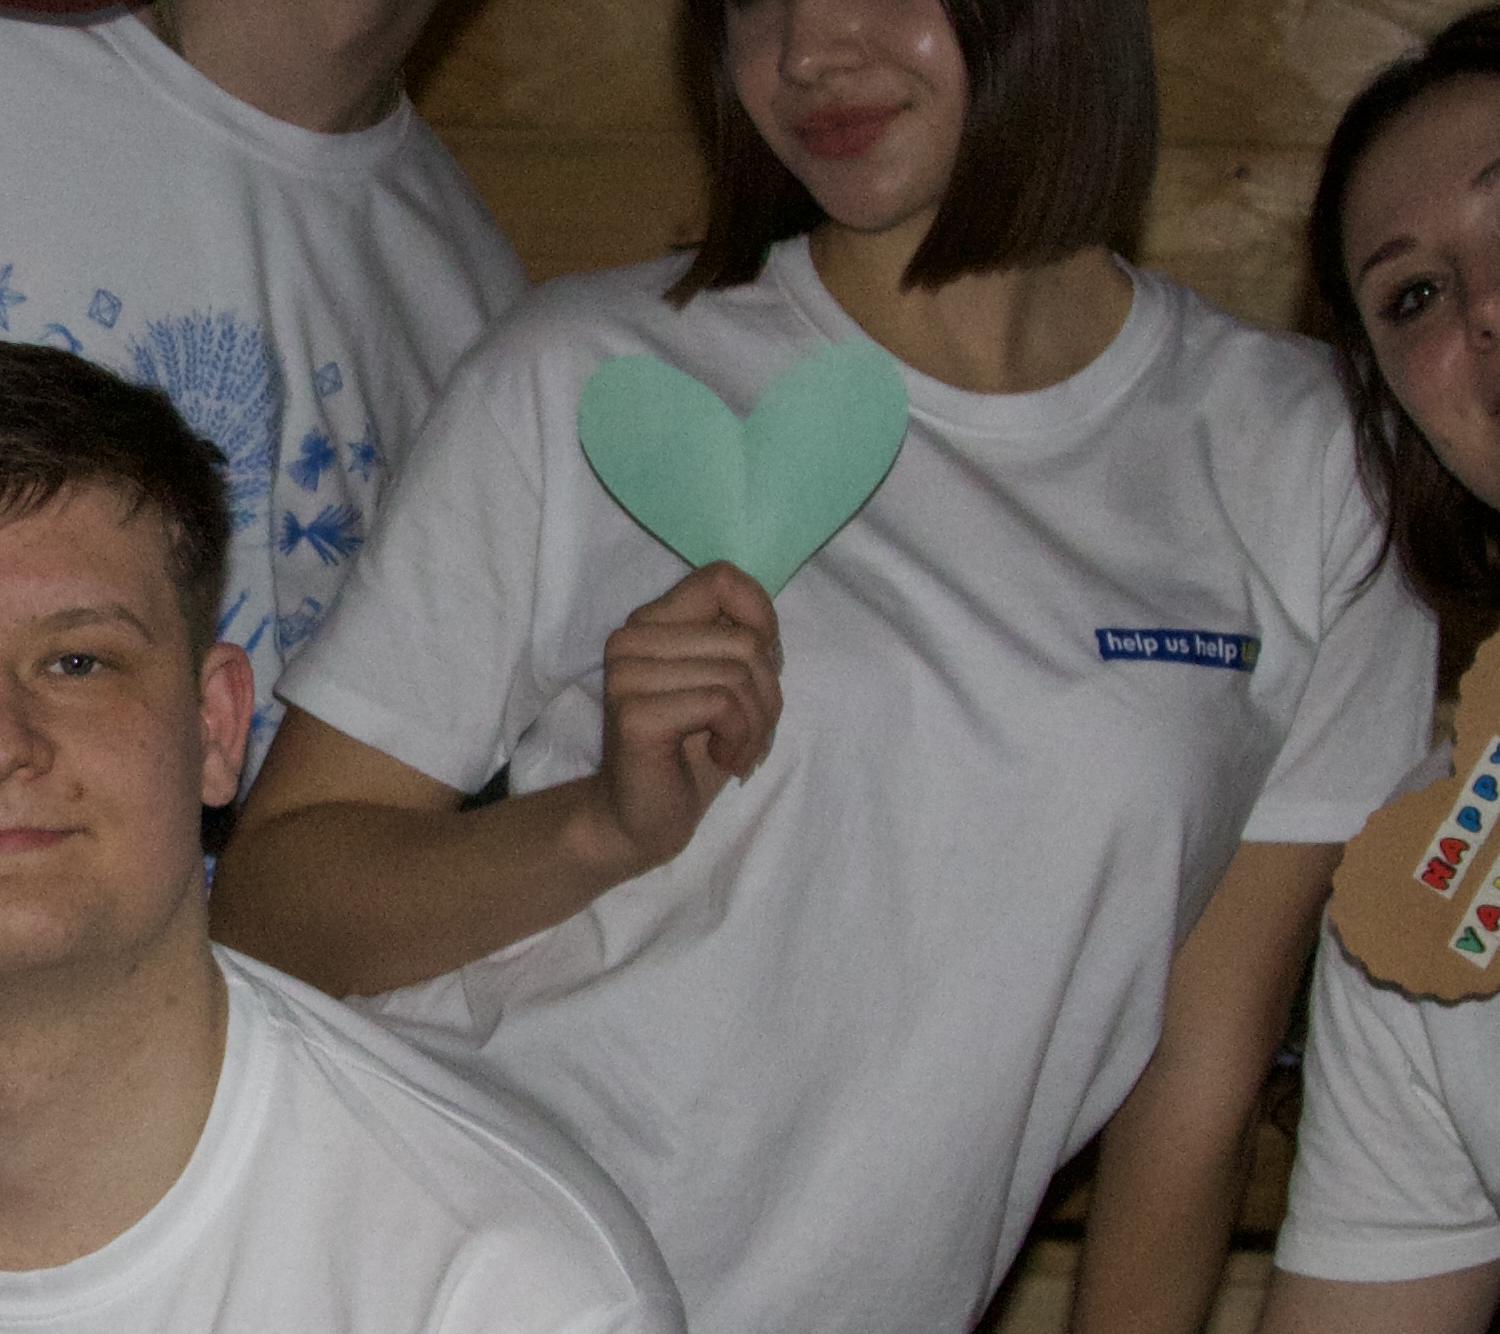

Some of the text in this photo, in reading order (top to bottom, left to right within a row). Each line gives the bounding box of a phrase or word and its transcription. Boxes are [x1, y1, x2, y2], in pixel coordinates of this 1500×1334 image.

[1106, 631, 1159, 657] help
[1164, 636, 1190, 654] us
[1195, 634, 1239, 664] help
